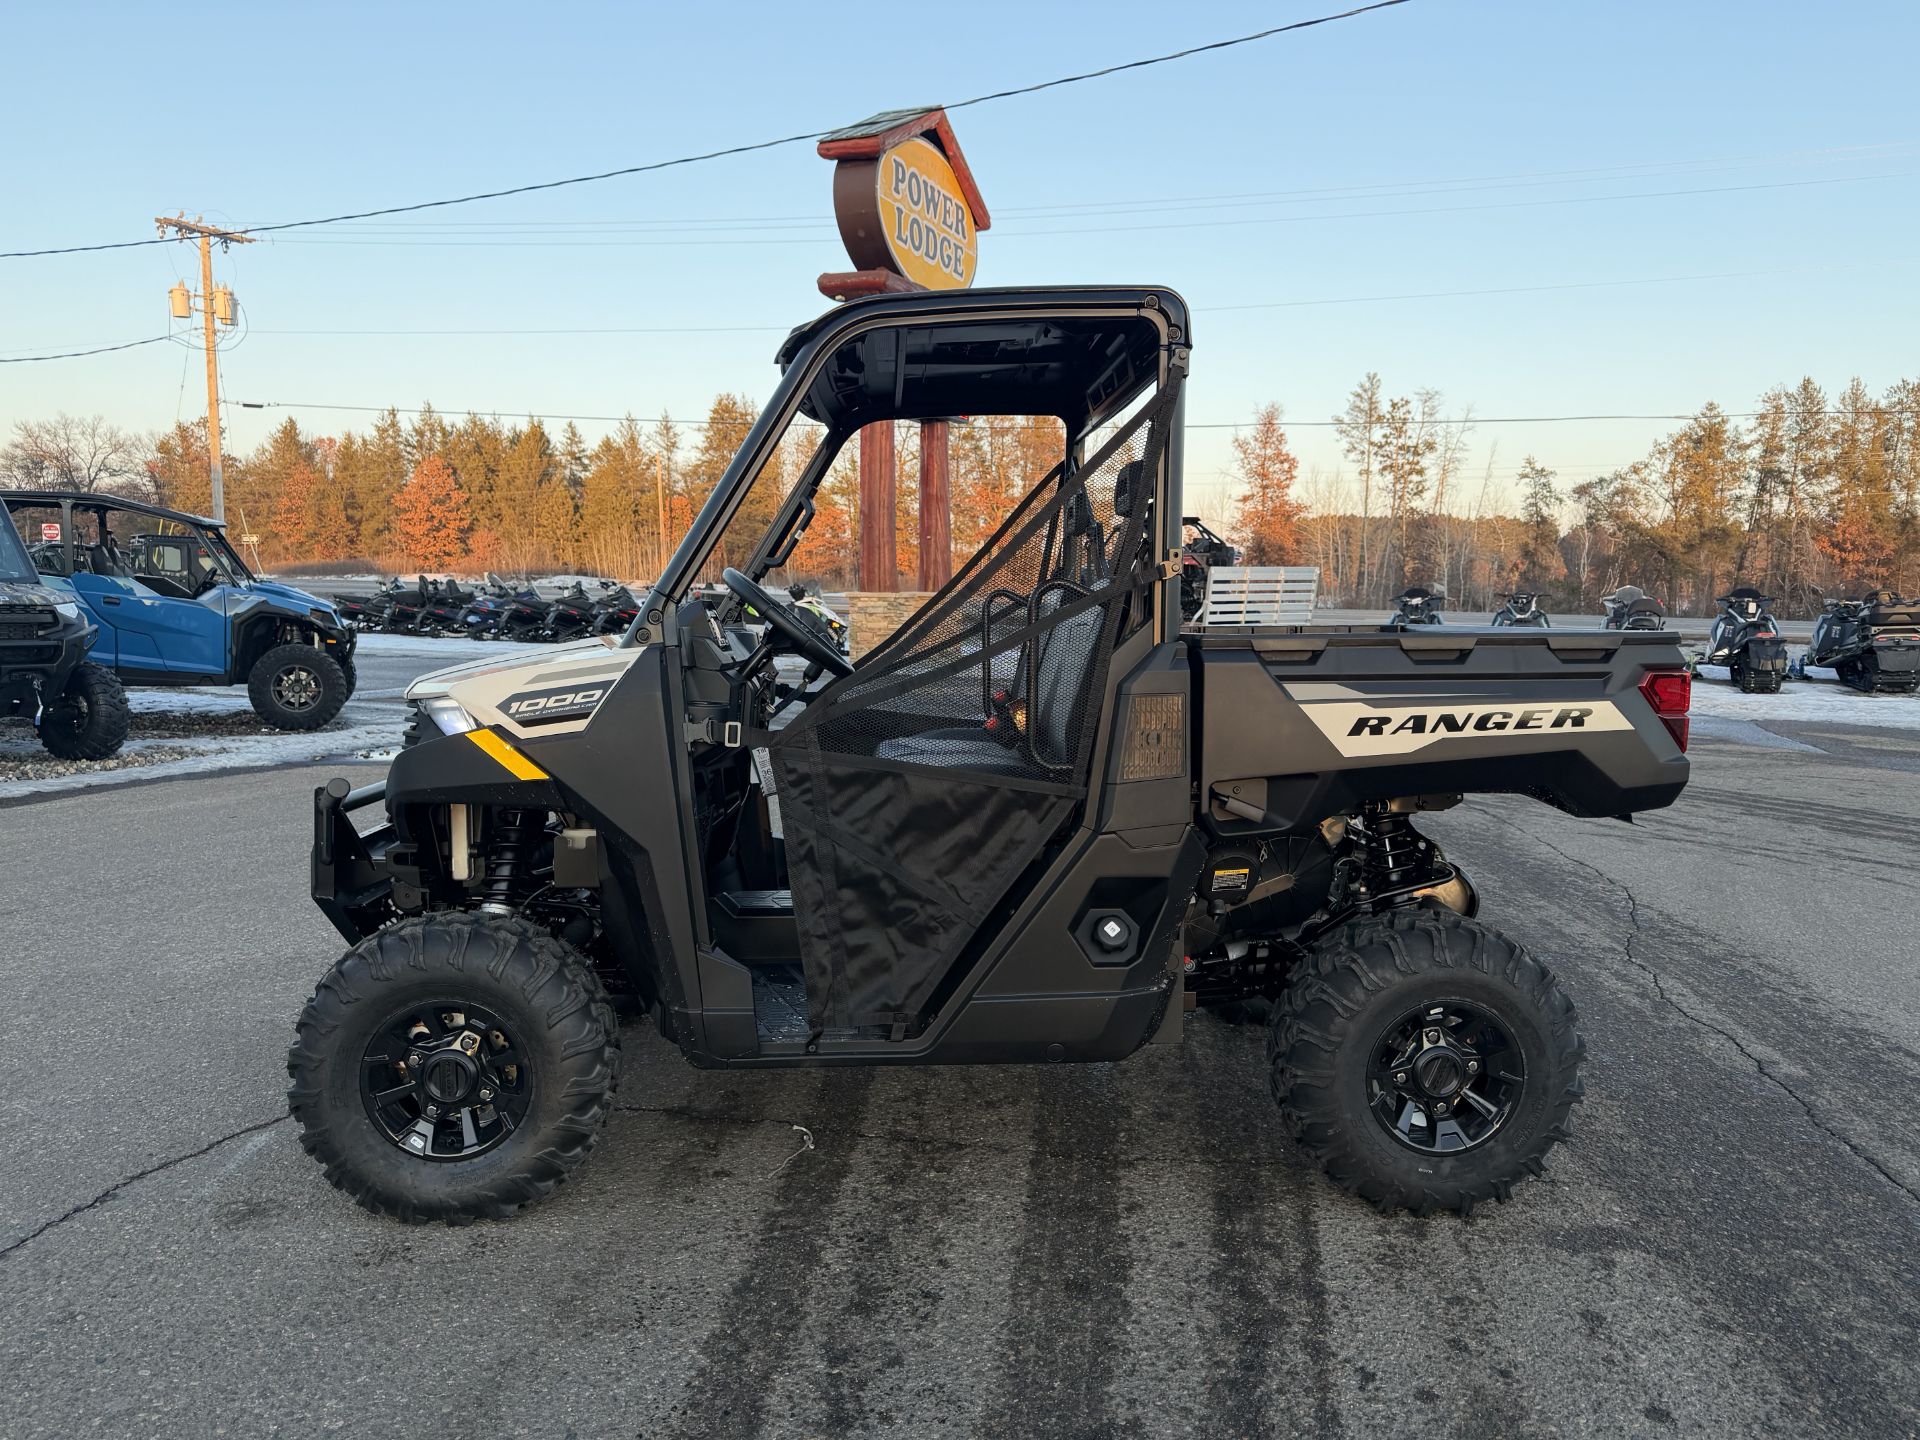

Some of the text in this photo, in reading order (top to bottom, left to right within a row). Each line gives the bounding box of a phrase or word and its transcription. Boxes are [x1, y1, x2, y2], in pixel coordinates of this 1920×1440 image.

[893, 158, 967, 240] POWER
[896, 206, 964, 279] LODGE
[508, 689, 603, 714] 1000
[1346, 707, 1594, 737] RANGER
